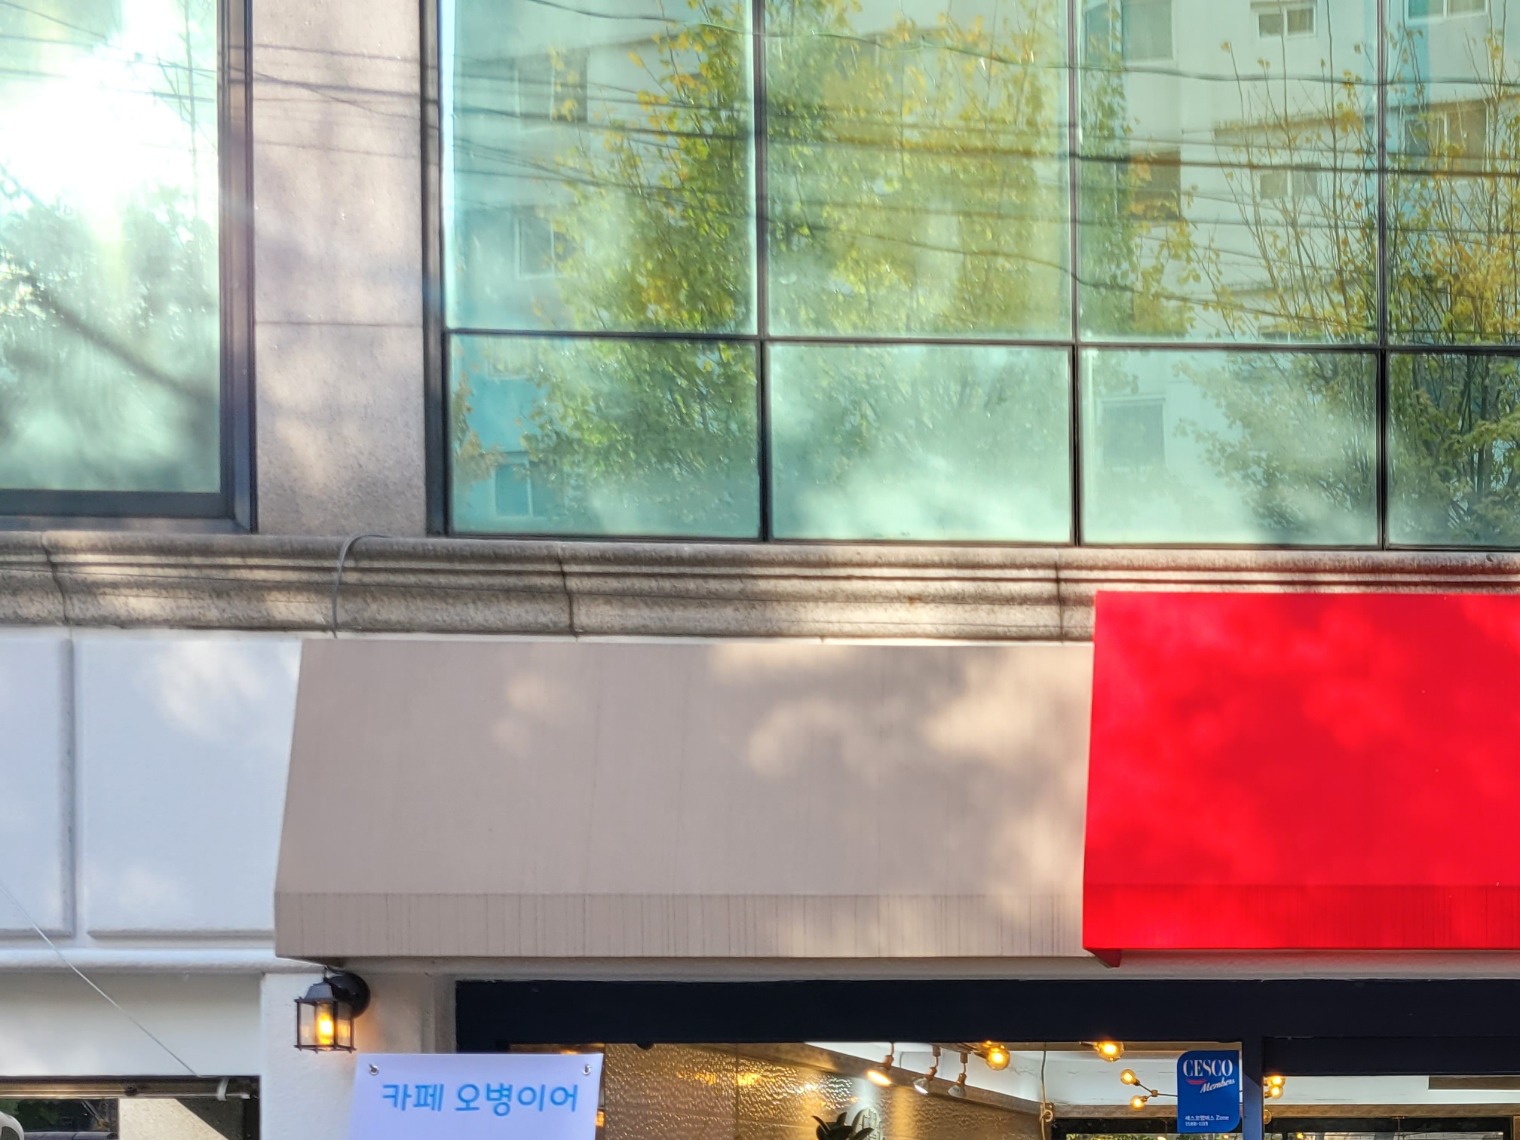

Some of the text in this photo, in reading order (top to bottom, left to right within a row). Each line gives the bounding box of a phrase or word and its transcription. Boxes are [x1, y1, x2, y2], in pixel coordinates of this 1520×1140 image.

[1182, 1058, 1234, 1077] CESCO
[1199, 1077, 1236, 1094] Members
[381, 1082, 579, 1117] 카페 오병이어
